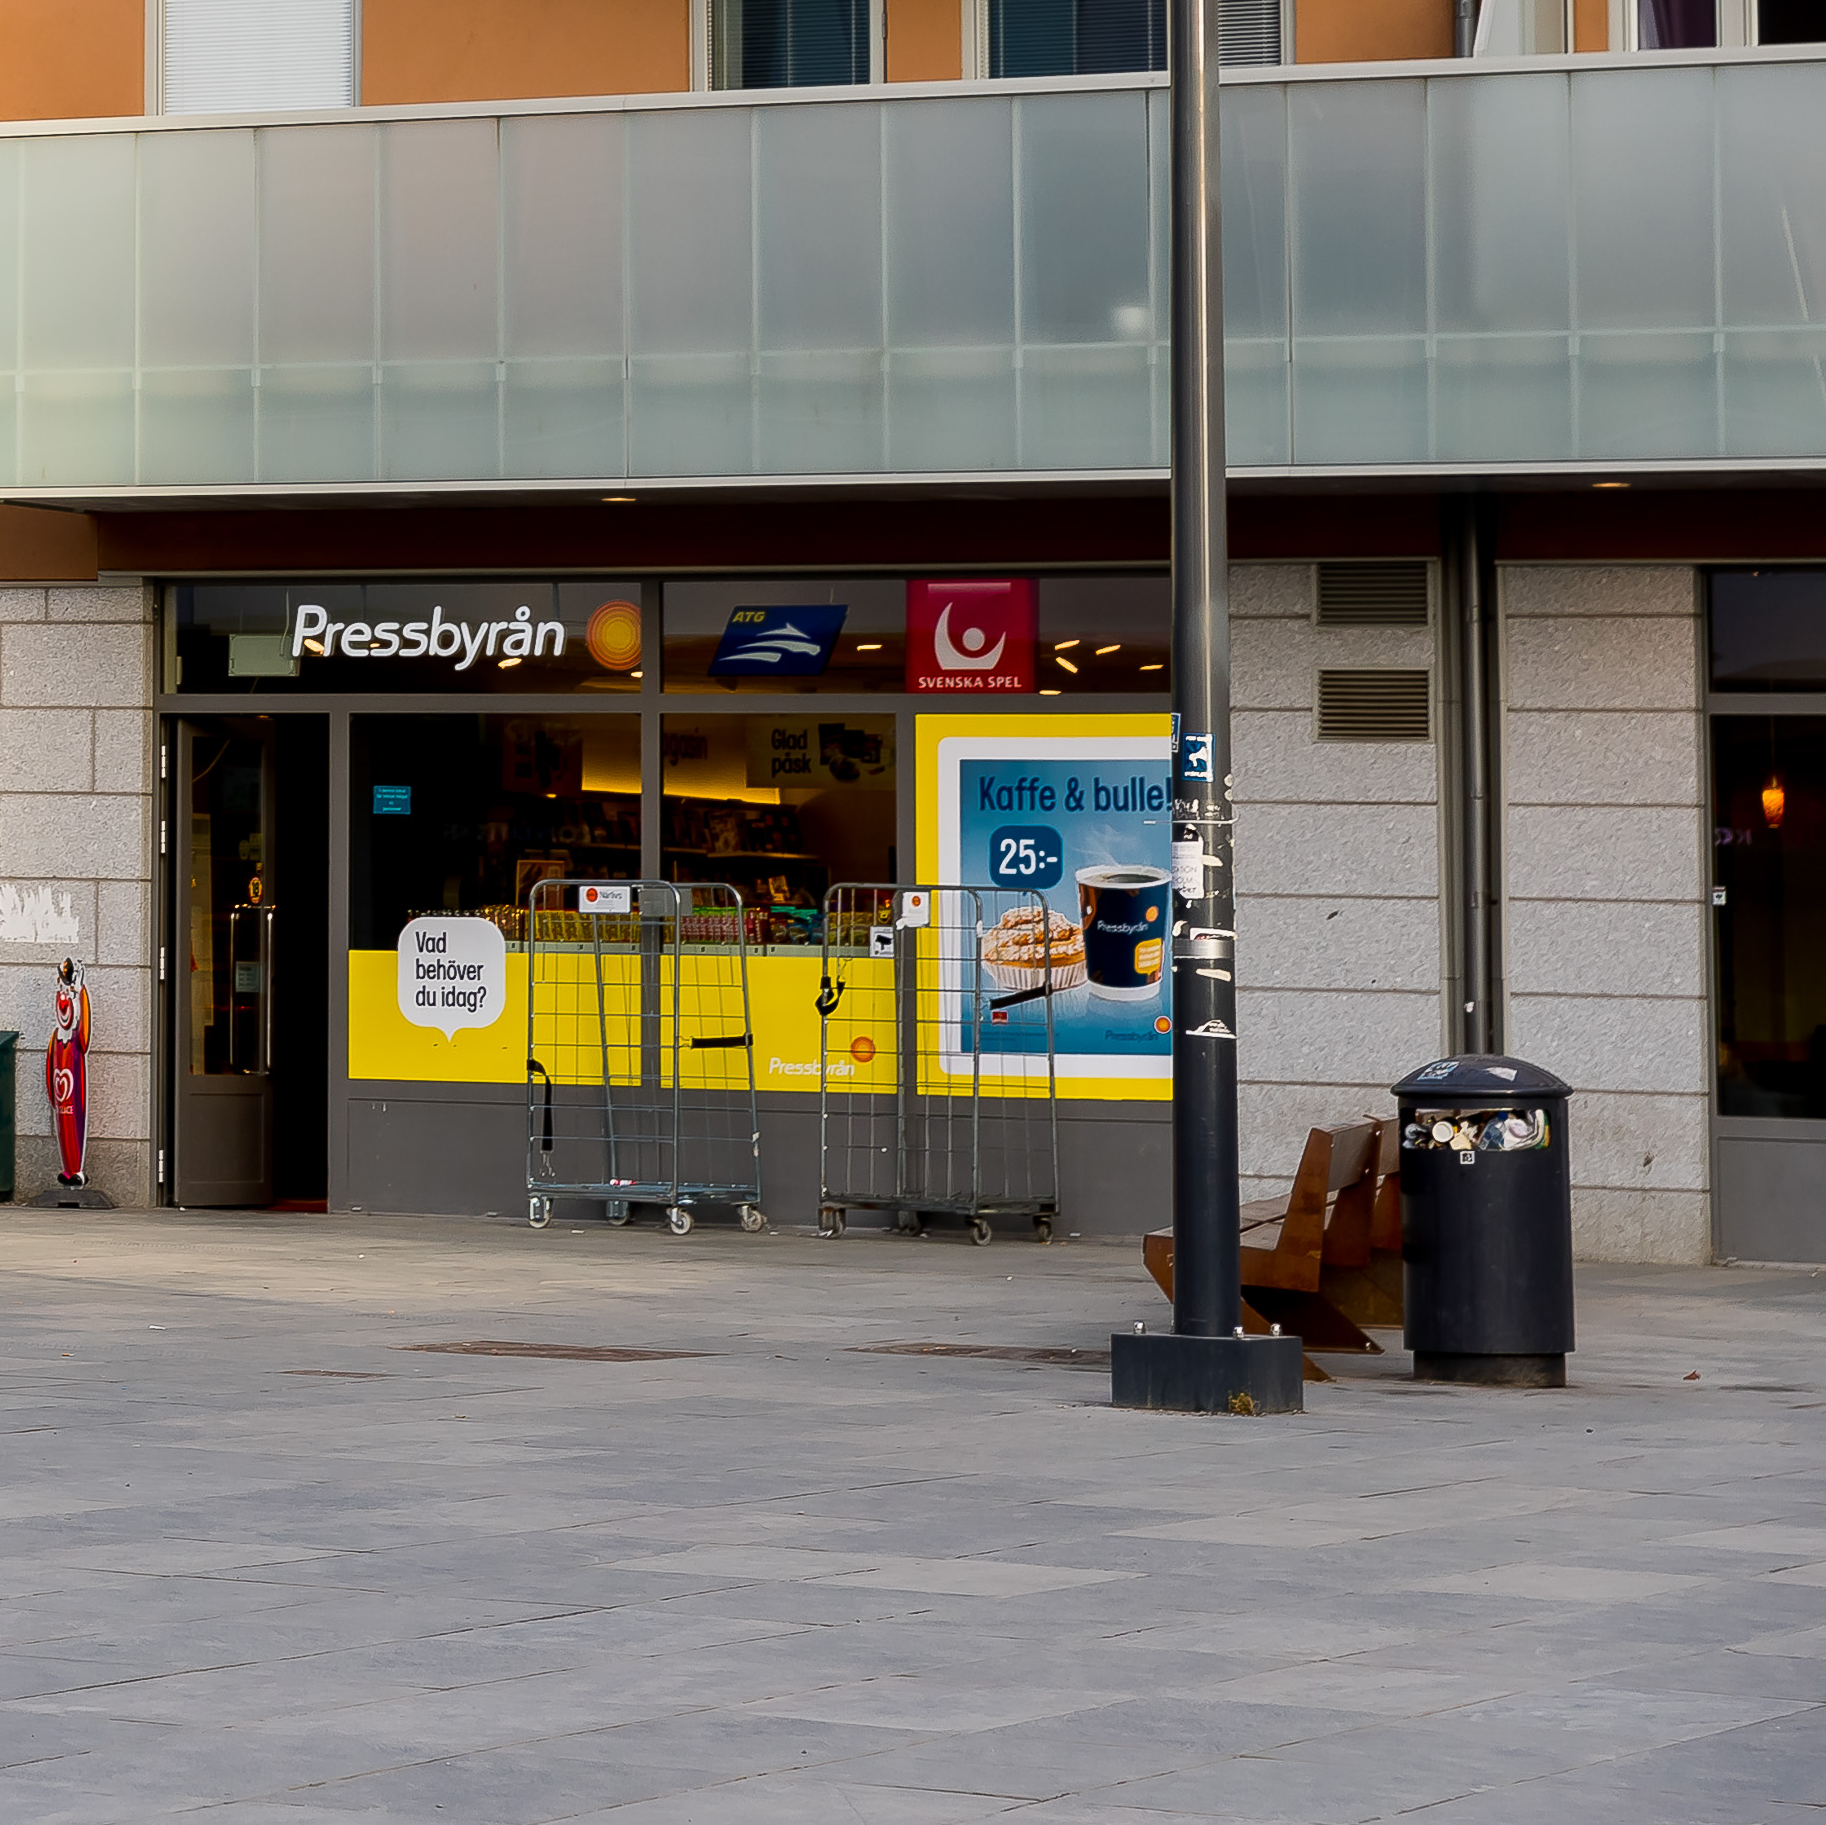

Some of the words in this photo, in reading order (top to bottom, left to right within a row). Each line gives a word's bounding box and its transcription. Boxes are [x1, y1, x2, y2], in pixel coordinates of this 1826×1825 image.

[733, 611, 766, 623] ATG
[292, 605, 566, 671] Pressbyrån
[918, 676, 983, 689] SVENSKA
[987, 676, 1023, 689] SPEL
[771, 728, 808, 751] Glad
[771, 752, 812, 779] påsk
[979, 776, 1057, 812] Kaffe
[1064, 776, 1085, 812] &
[1093, 776, 1172, 812] bulle!
[998, 838, 1058, 875] 25:-
[1097, 920, 1149, 934] Pressbyrån
[415, 931, 447, 953] Vad
[415, 958, 484, 981] behöver
[415, 985, 437, 1007] du
[441, 986, 487, 1013] idag?
